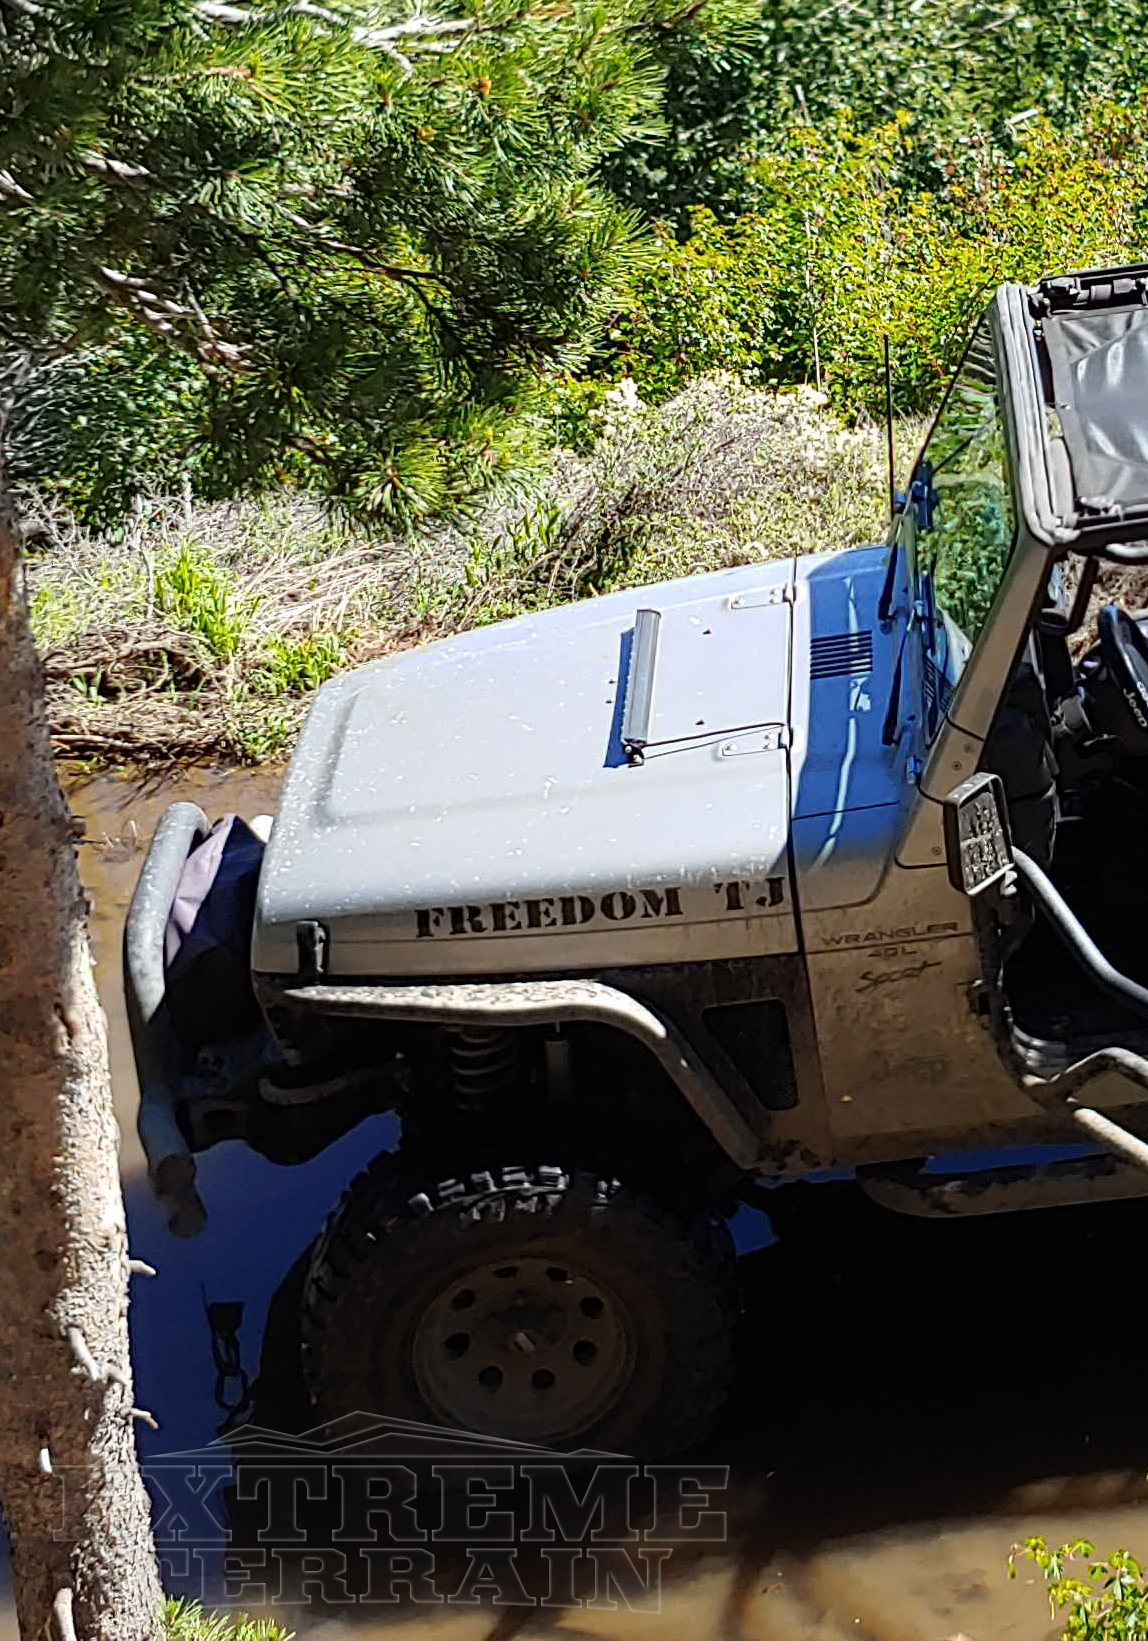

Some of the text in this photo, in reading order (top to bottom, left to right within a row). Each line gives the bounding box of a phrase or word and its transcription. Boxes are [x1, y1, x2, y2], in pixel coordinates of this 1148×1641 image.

[415, 875, 786, 938] FREEDOM TJ
[819, 921, 958, 947] WRANGLER
[854, 959, 944, 994] Sport
